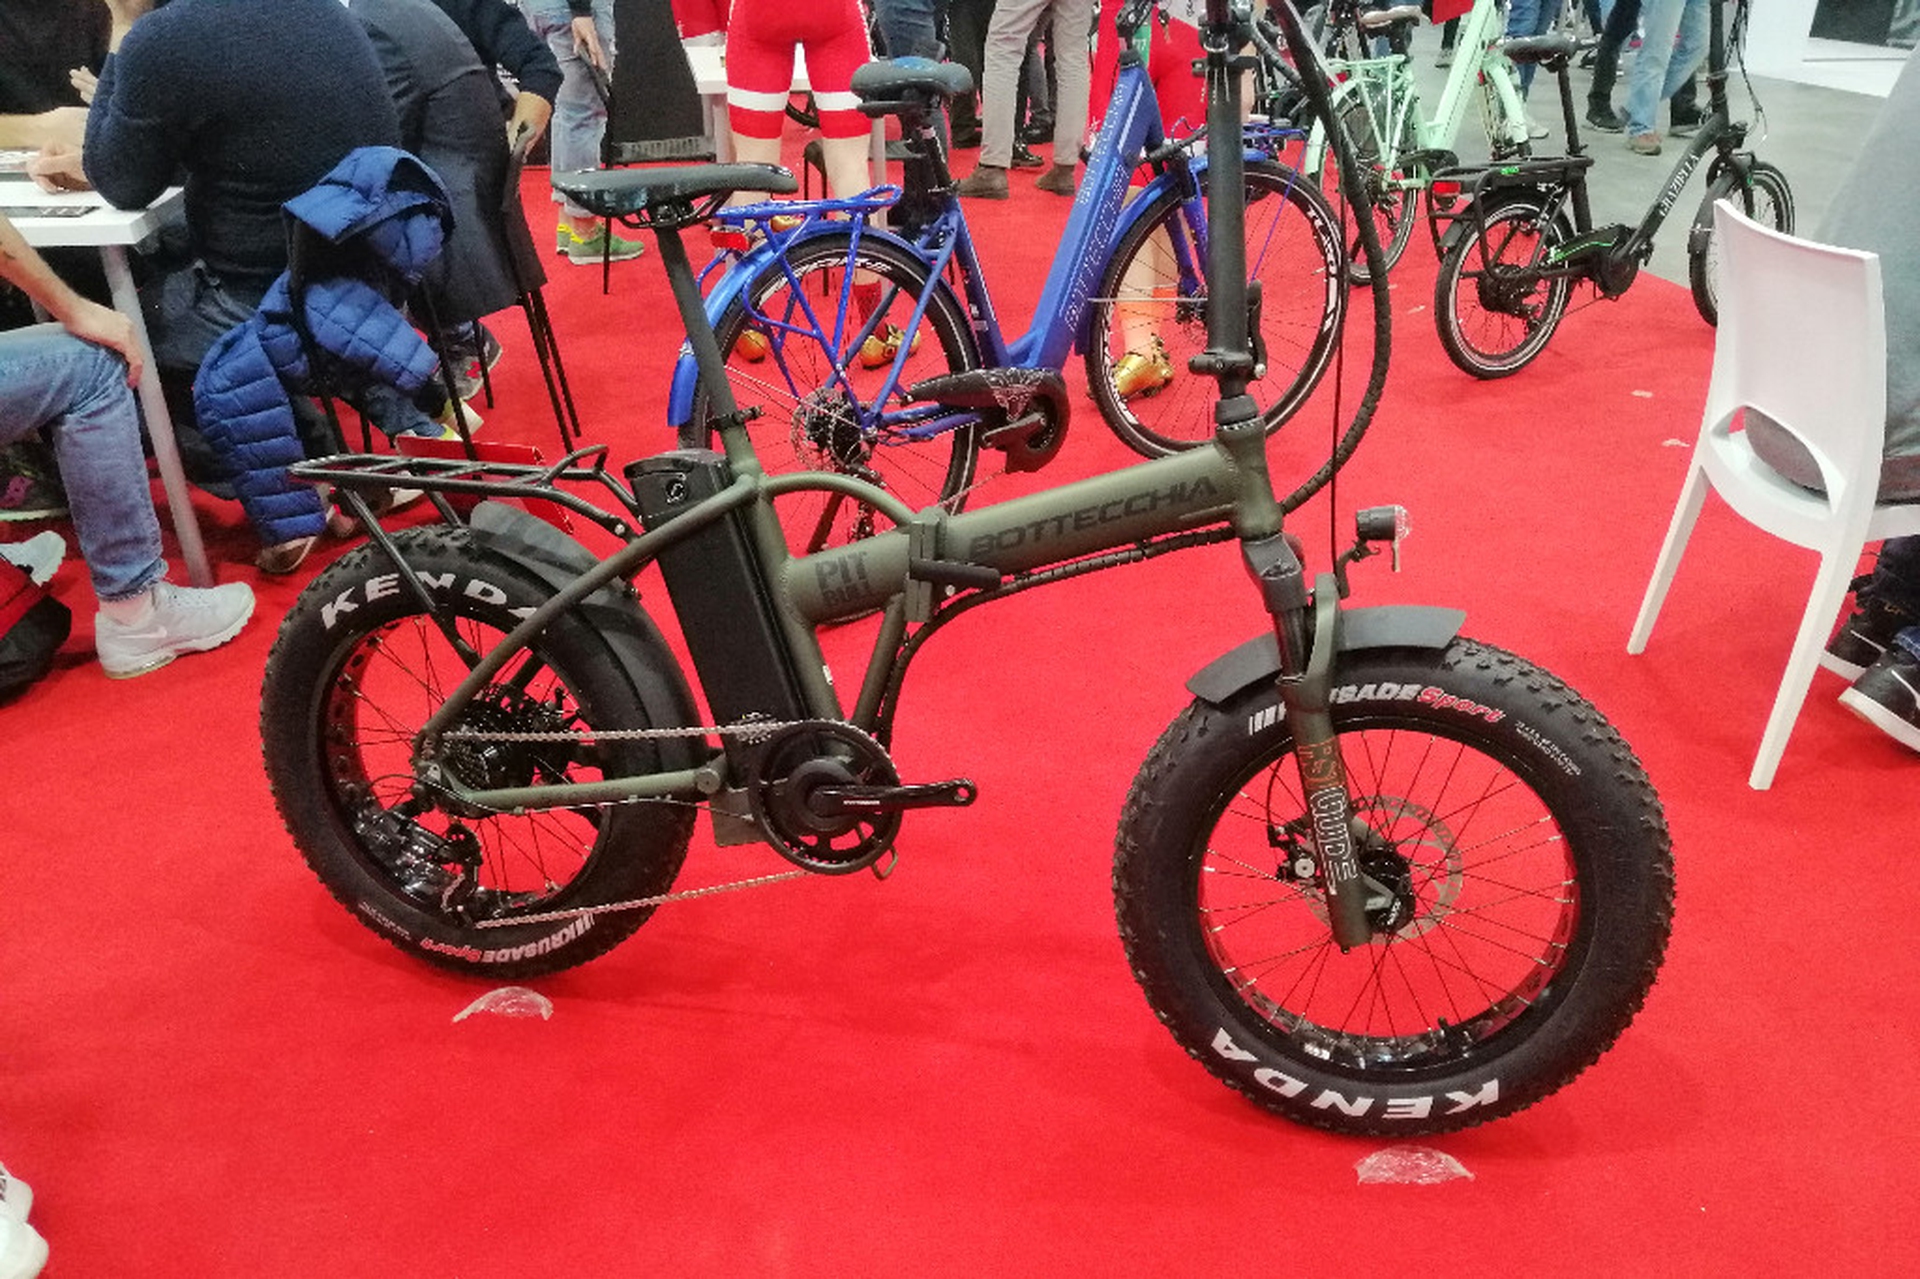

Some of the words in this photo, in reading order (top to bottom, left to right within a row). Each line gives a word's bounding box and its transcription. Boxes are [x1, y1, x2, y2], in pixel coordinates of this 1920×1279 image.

[969, 475, 1218, 562] BOTTECCHIA
[814, 550, 868, 592] PIT
[1417, 686, 1507, 724] Sport
[1210, 1027, 1500, 1120] KENDA
